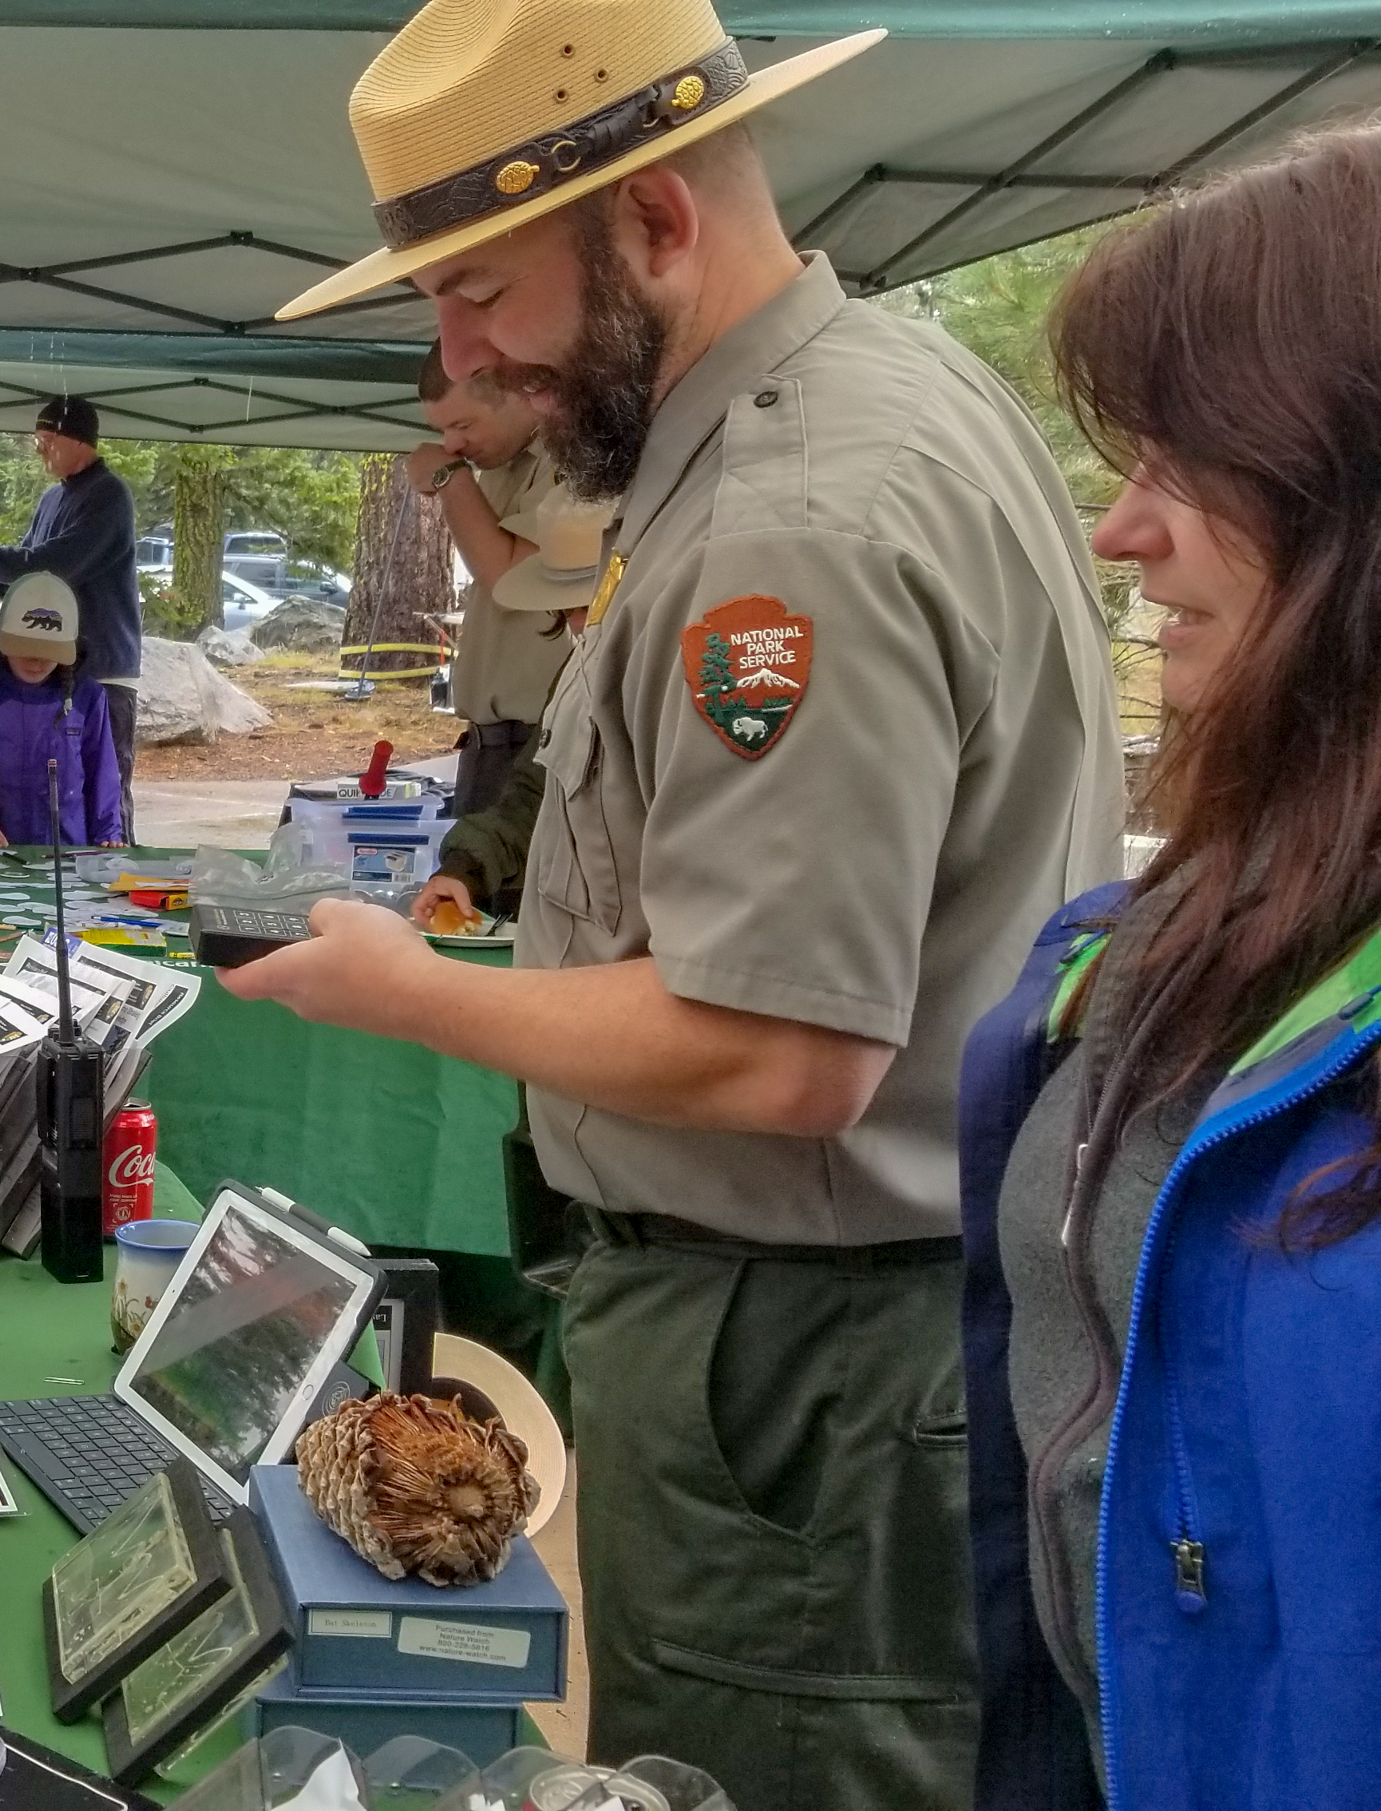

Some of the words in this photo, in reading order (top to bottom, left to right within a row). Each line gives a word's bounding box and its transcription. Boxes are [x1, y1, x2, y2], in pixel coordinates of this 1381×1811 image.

[730, 626, 804, 646] NATIONAL
[746, 640, 786, 655] PARK
[739, 650, 797, 669] SERVICE
[341, 1619, 377, 1628] Skeleton
[435, 1624, 475, 1638] Purchased
[476, 1630, 495, 1638] from
[439, 1632, 465, 1643] Nature
[466, 1635, 490, 1645] Watch
